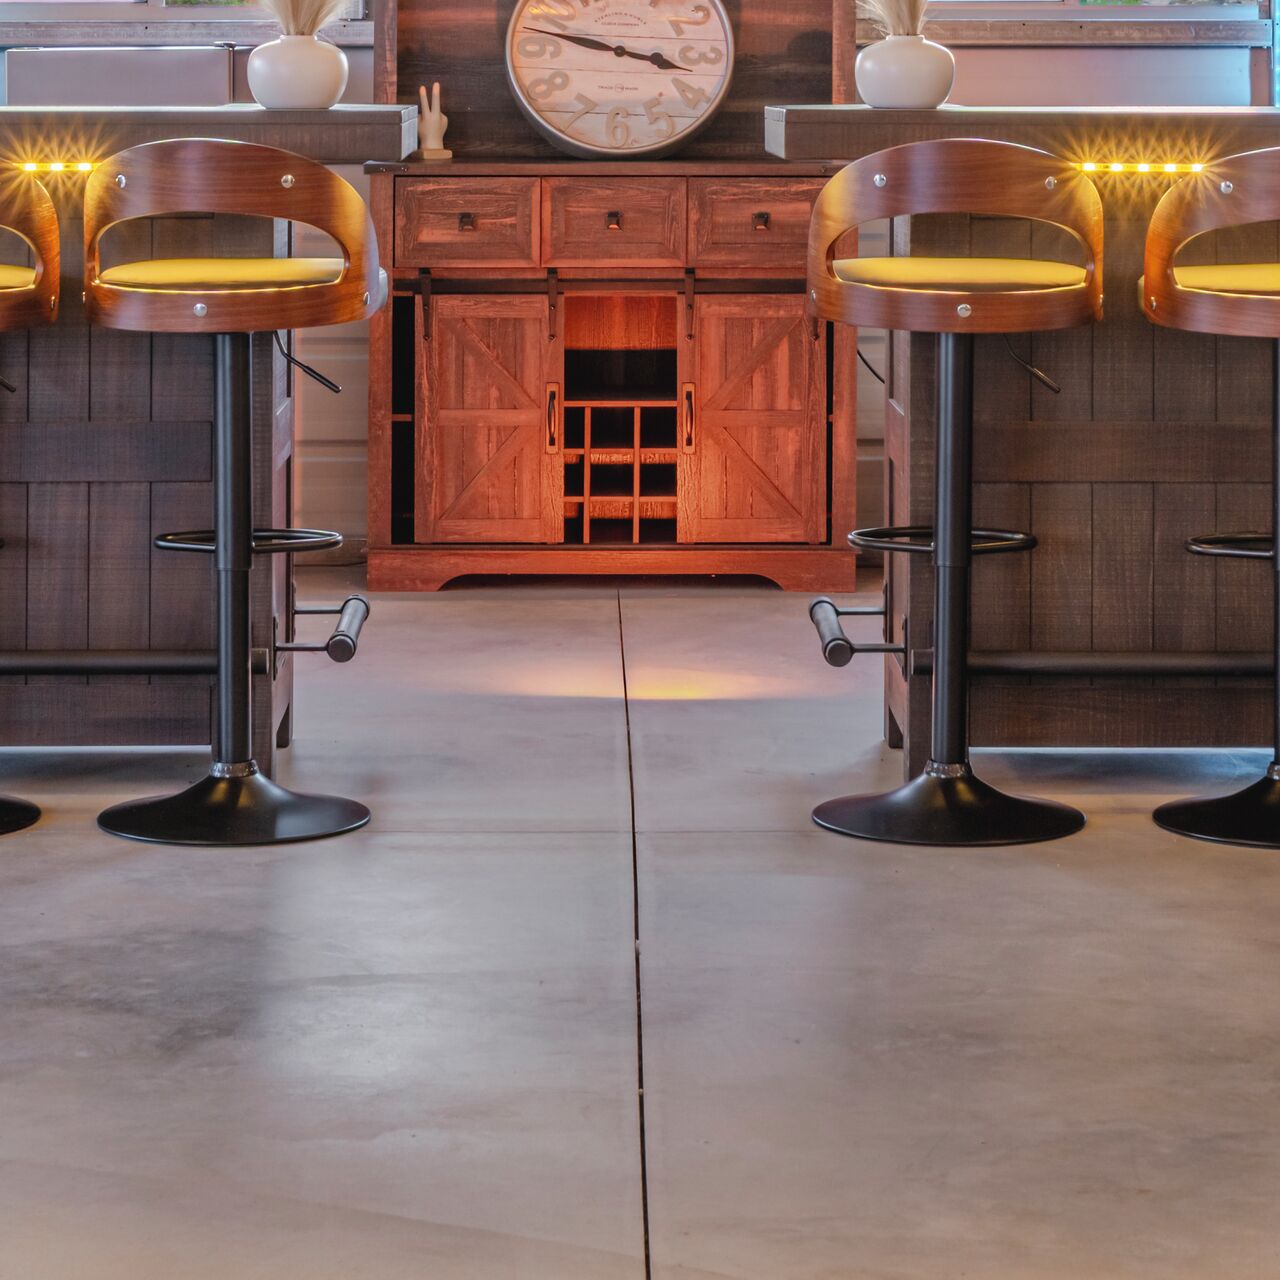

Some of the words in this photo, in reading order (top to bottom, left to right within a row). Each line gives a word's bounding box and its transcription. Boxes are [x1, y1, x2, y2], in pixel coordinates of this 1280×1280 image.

[666, 4, 711, 37] 2
[517, 35, 562, 60] 9
[678, 44, 723, 66] 3
[527, 70, 571, 101] 8
[671, 77, 711, 110] 4
[562, 92, 599, 132] 7
[605, 106, 632, 148] 6
[643, 96, 676, 139] 5
